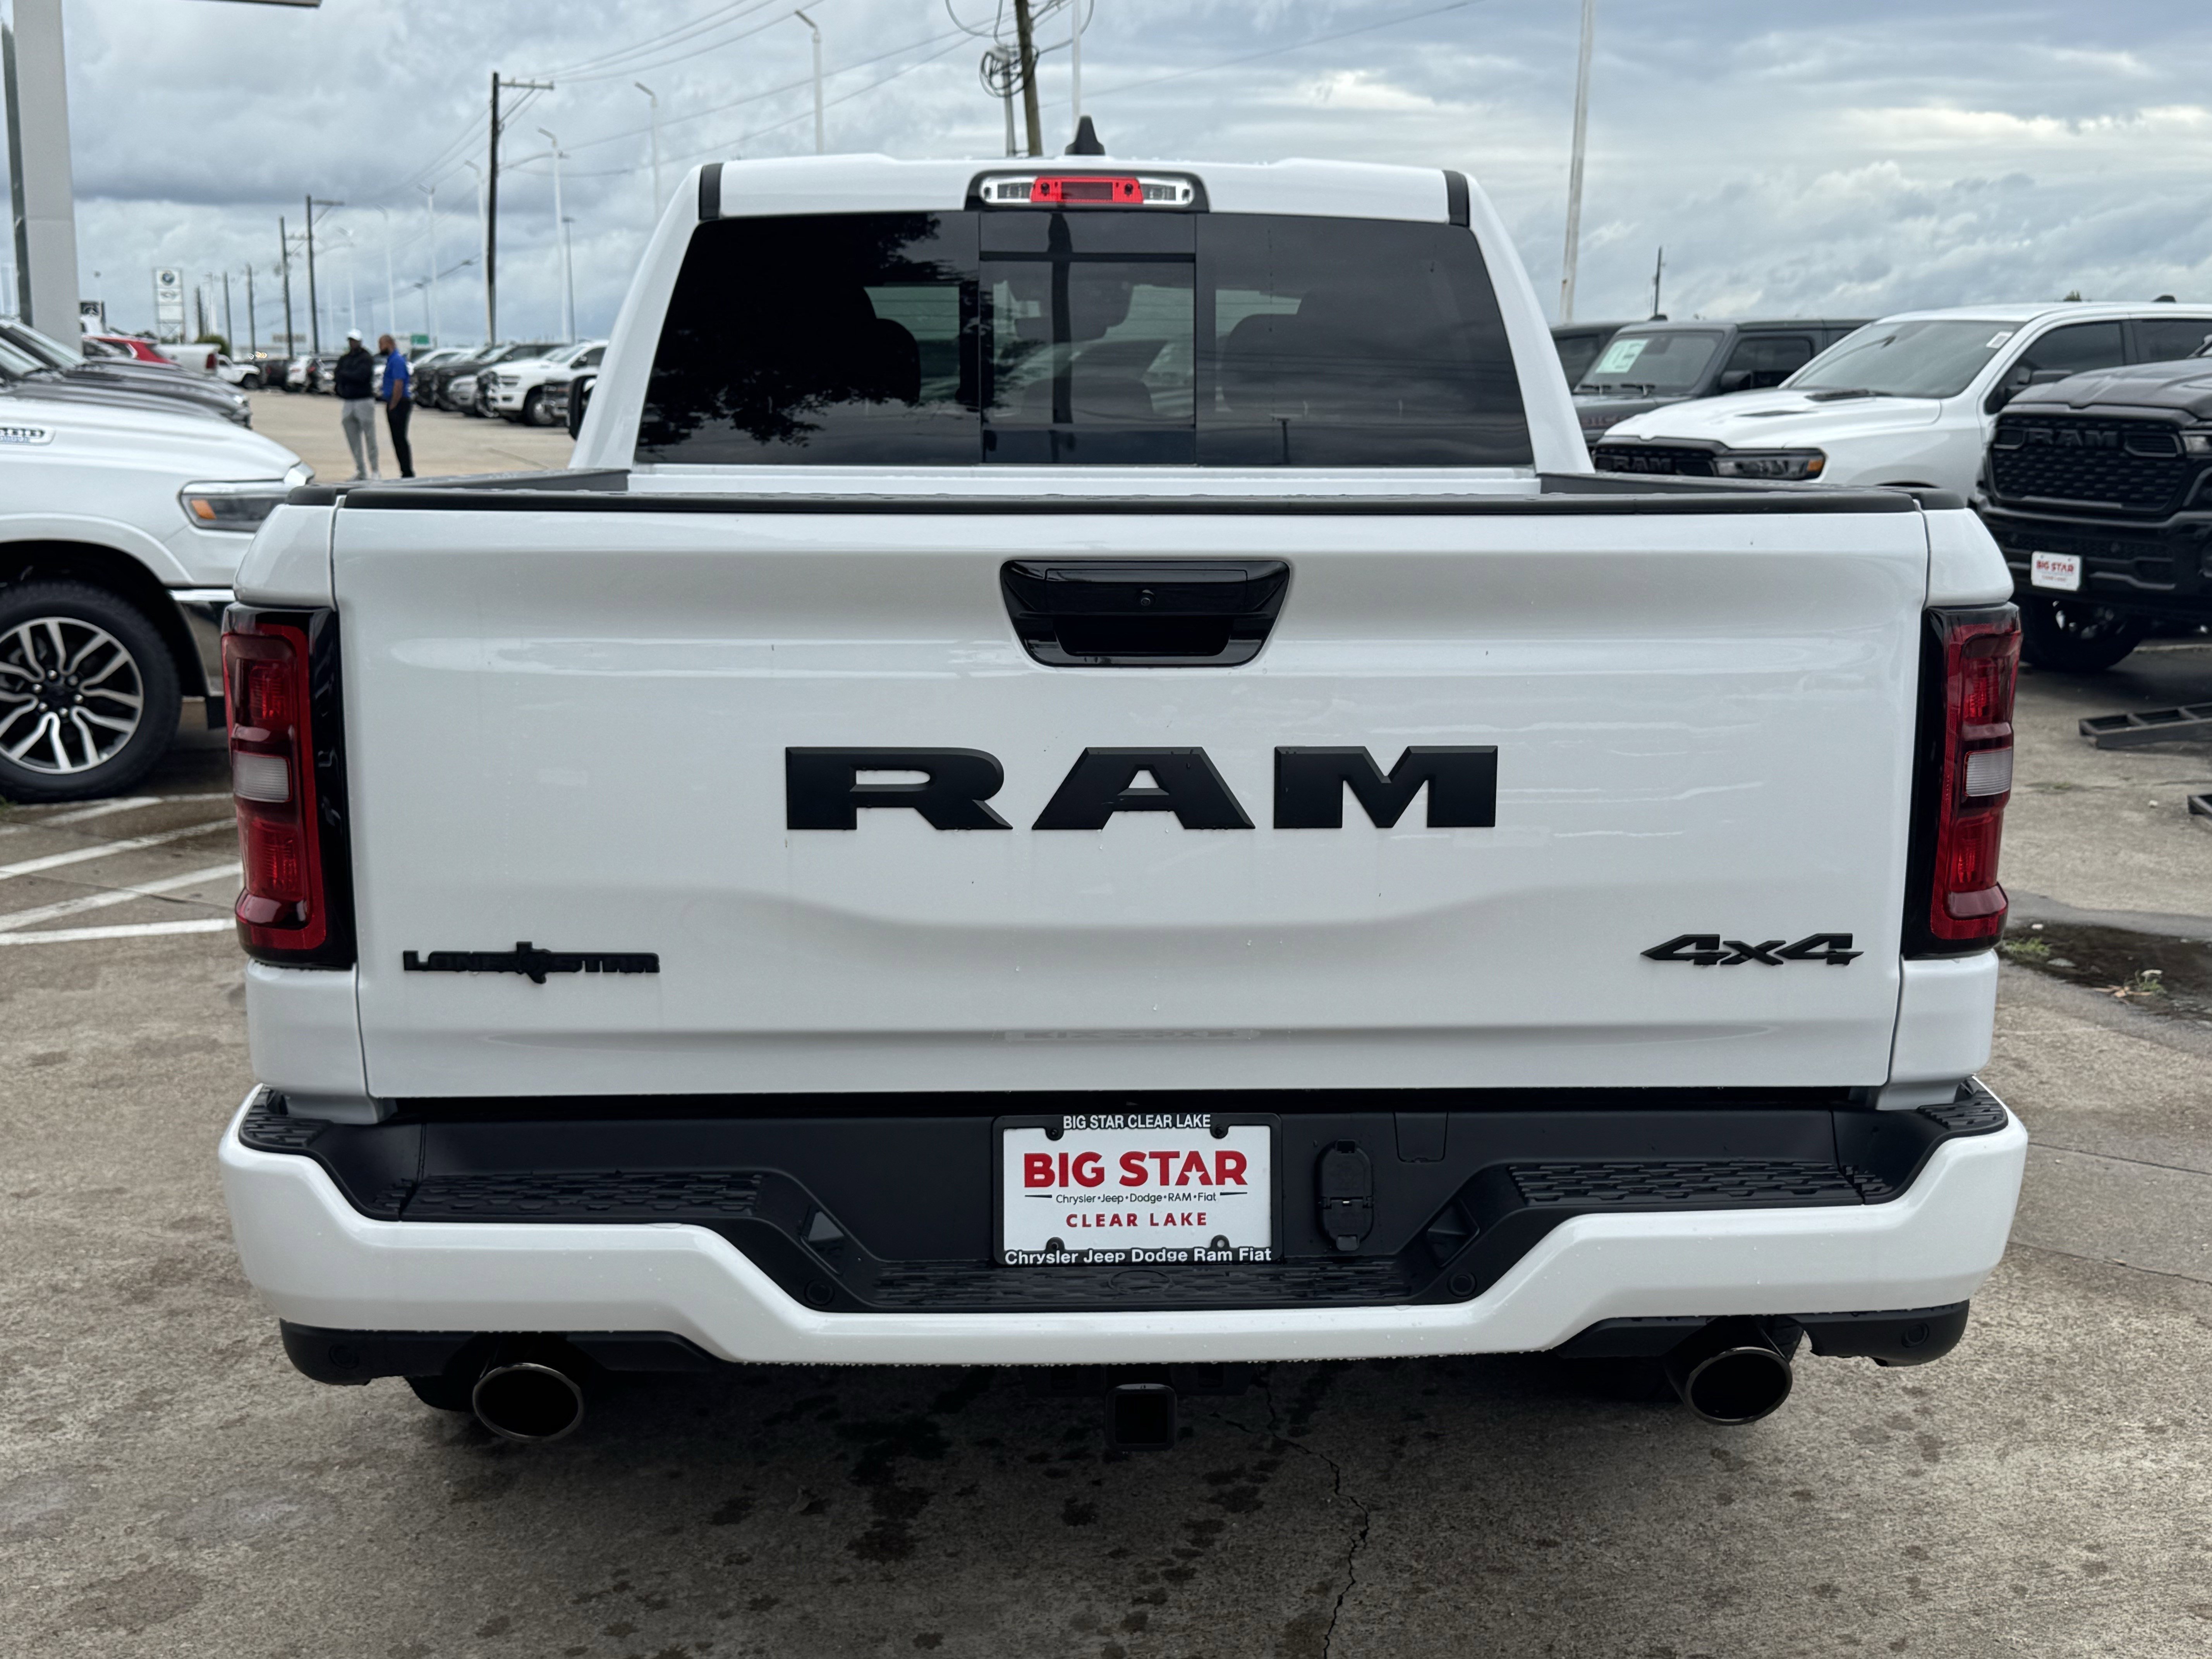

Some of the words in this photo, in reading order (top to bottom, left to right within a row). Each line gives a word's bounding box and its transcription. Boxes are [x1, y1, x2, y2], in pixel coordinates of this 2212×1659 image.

[2028, 427, 2118, 447] RAM
[1612, 455, 1672, 472] RAM
[2036, 560, 2049, 570] BIG
[2051, 562, 2074, 573] STAR
[785, 745, 1498, 830] RAM
[1063, 1115, 1086, 1128] BIG
[1090, 1115, 1124, 1128] STAR
[1128, 1115, 1172, 1128] CLEAR
[1176, 1114, 1211, 1127] LAKE
[1024, 1151, 1104, 1188] BIG
[1119, 1150, 1248, 1187] STAR
[1056, 1194, 1096, 1205] Chrysler
[1101, 1194, 1124, 1204] Jeep
[1130, 1193, 1163, 1204] Dodge
[1168, 1193, 1192, 1201] RAM
[1197, 1192, 1216, 1201] Fiat
[1066, 1213, 1138, 1228] CLEAR
[1150, 1212, 1207, 1226] LAKE
[1005, 1250, 1079, 1265] Chrysler
[1083, 1249, 1125, 1264] Jeep
[1131, 1249, 1188, 1262] Dodge
[1194, 1248, 1233, 1262] Ram
[1239, 1247, 1272, 1261] Fiat
